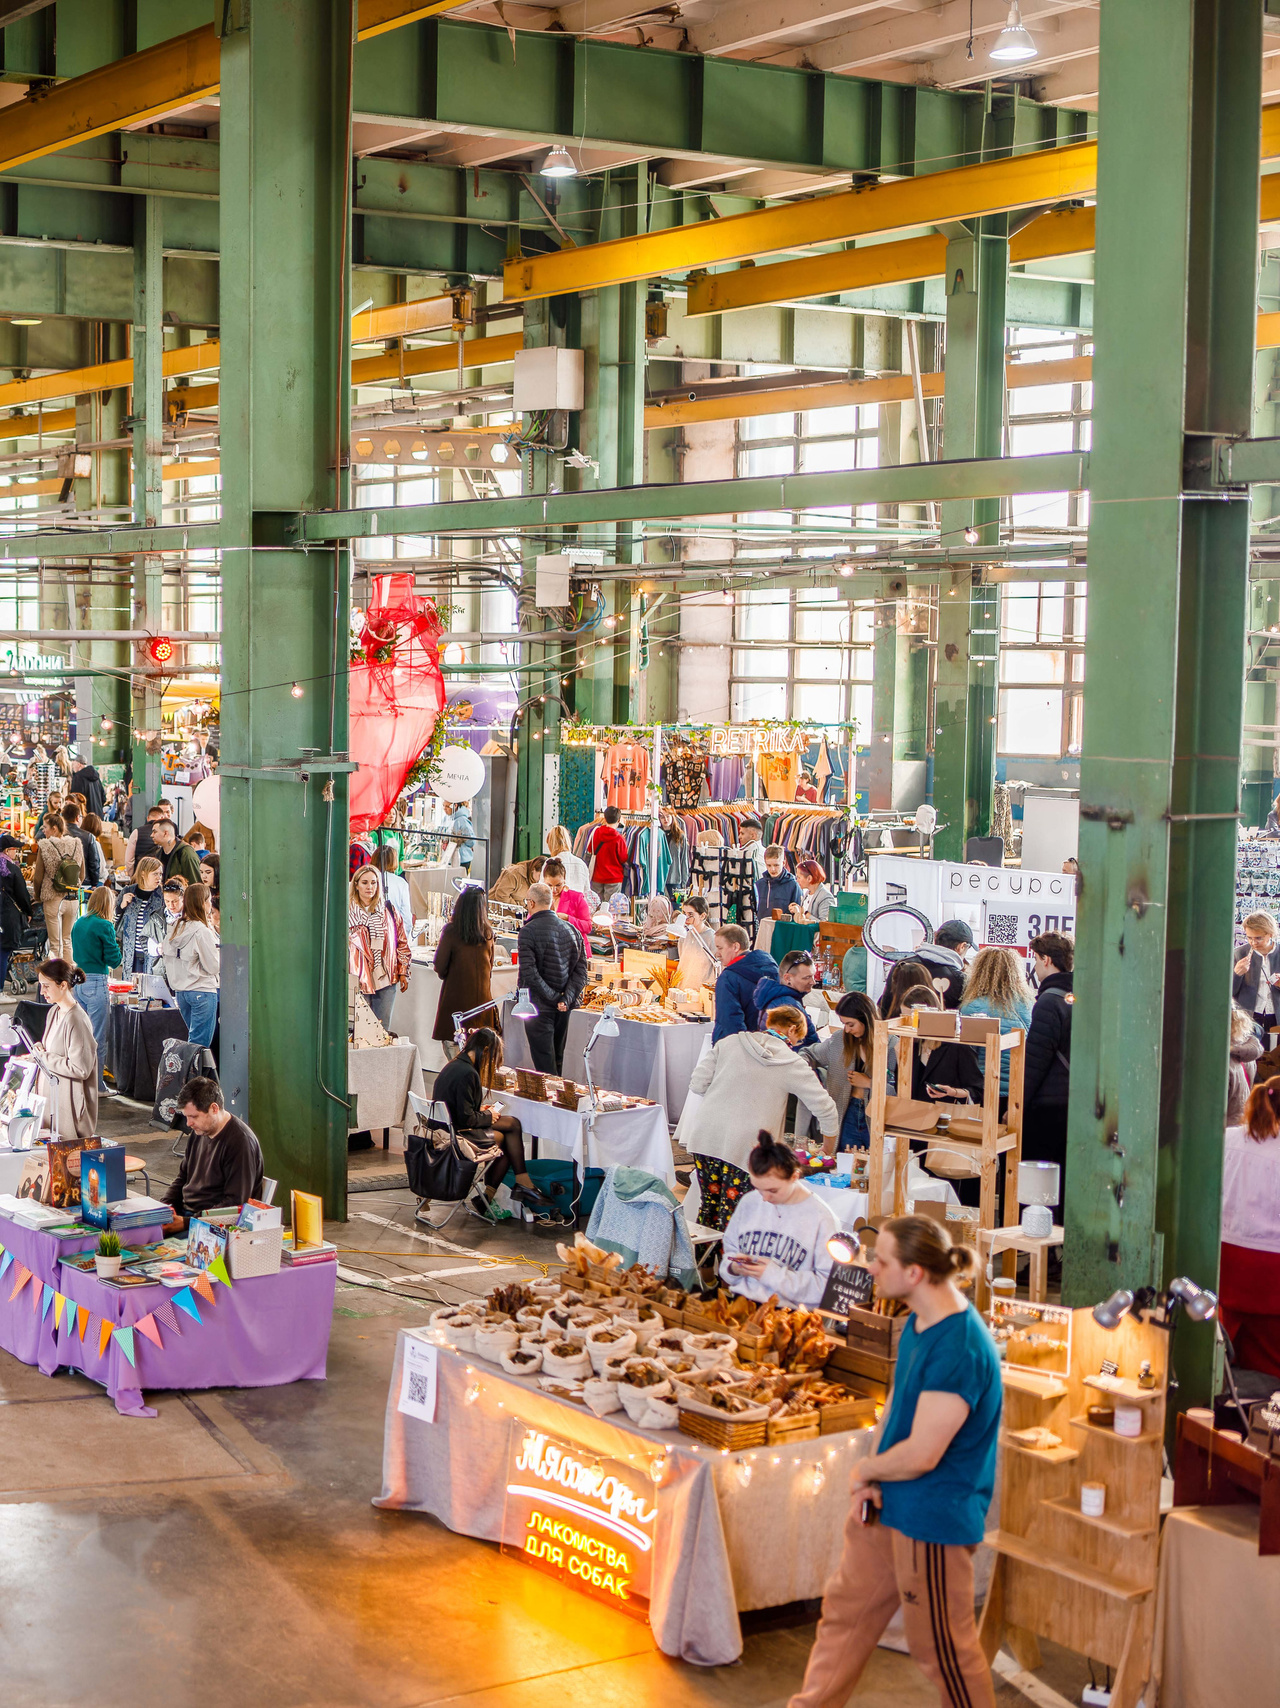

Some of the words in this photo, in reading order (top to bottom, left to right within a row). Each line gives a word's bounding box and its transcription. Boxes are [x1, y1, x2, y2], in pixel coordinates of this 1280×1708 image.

[447, 773, 470, 781] МЕЧТА
[831, 1265, 873, 1290] АКЦИЯ
[526, 1511, 633, 1574] ЛАКОМСТВА
[524, 1535, 565, 1568] ДЛЯ
[568, 1556, 631, 1600] СОБАК
